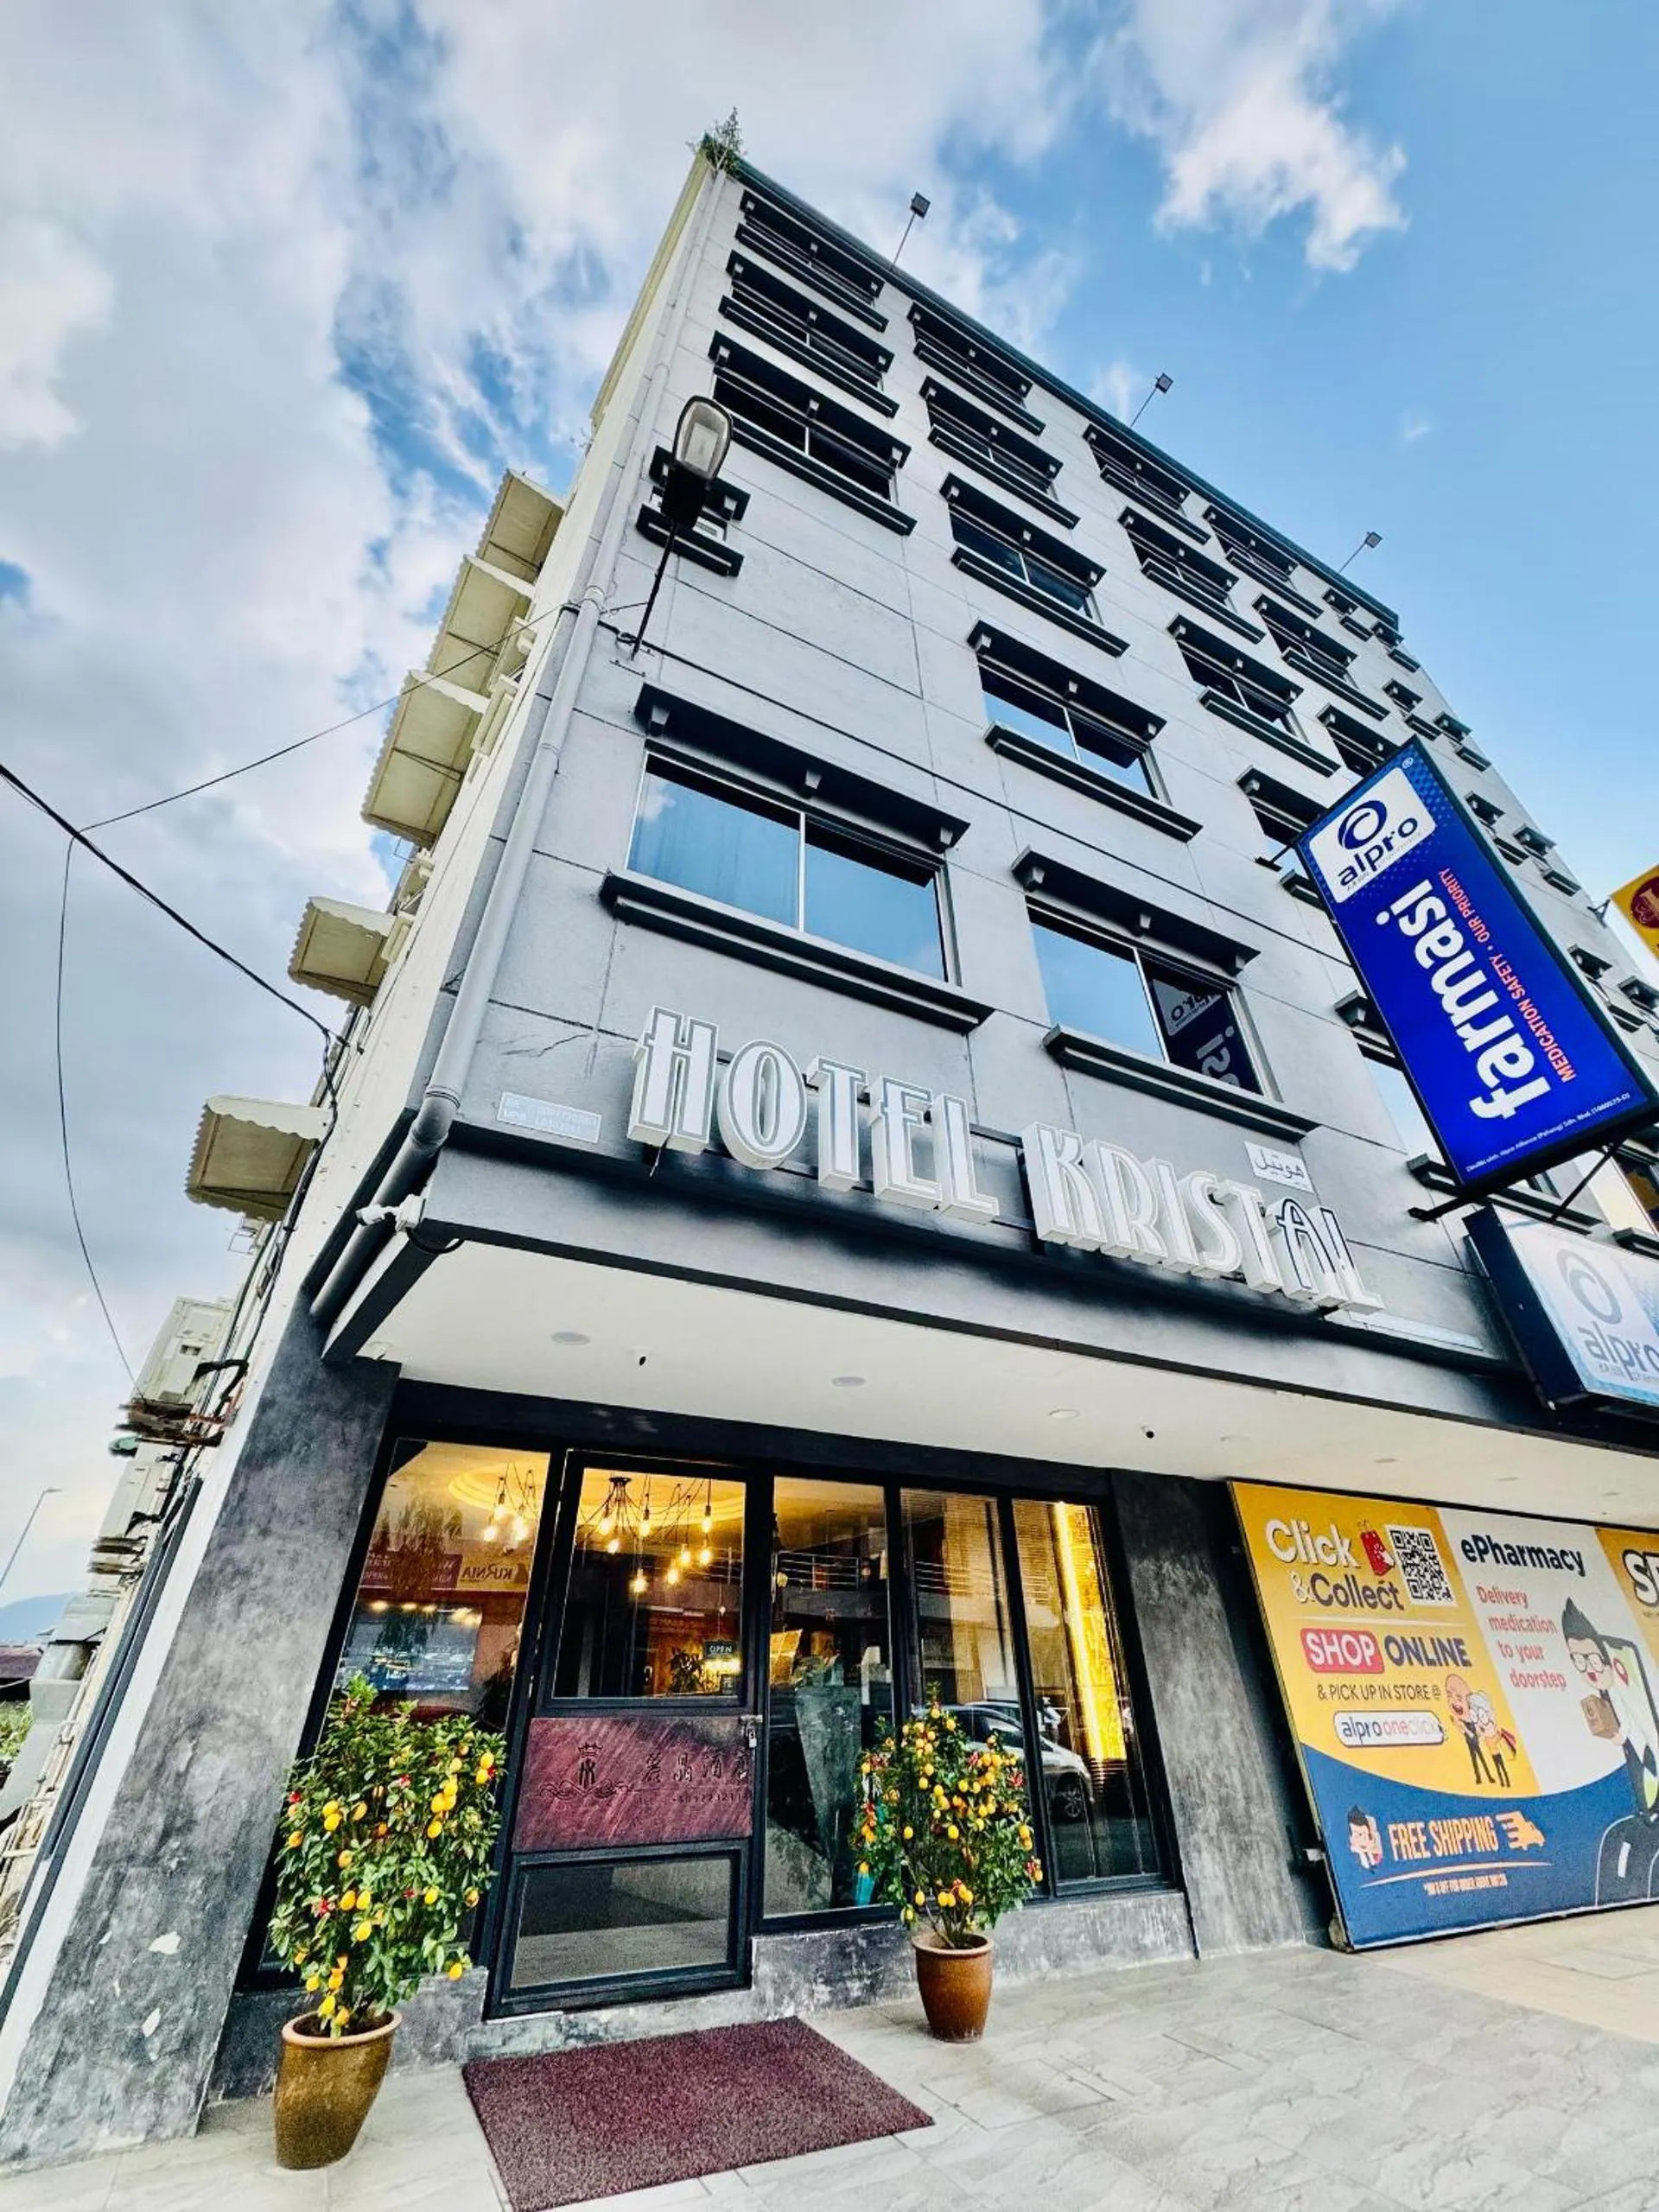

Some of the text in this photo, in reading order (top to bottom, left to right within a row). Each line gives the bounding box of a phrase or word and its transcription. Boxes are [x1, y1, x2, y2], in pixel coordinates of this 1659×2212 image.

[1338, 817, 1418, 886] alpro
[1438, 868, 1577, 1083] MEDICATION SAFETY OUR PRIORITY
[1375, 879, 1552, 1119] farmasi
[626, 1005, 1385, 1314] HOTEL KRISTAL
[1266, 1518, 1360, 1569] Click
[1460, 1534, 1586, 1578] ePharmacy
[1476, 1586, 1529, 1608] Delivery
[1488, 1613, 1558, 1634] medication
[709, 1644, 733, 1654] OPEN
[1306, 1630, 1472, 1668] SHOP ONLINE
[1497, 1640, 1545, 1663] to your
[1330, 1684, 1357, 1701] PICK
[1360, 1684, 1377, 1701] UP
[1378, 1684, 1393, 1700] IN
[1394, 1684, 1431, 1700] STORE
[1510, 1669, 1567, 1692] doorstep
[1388, 1815, 1500, 1861] FREE SHIPPING
